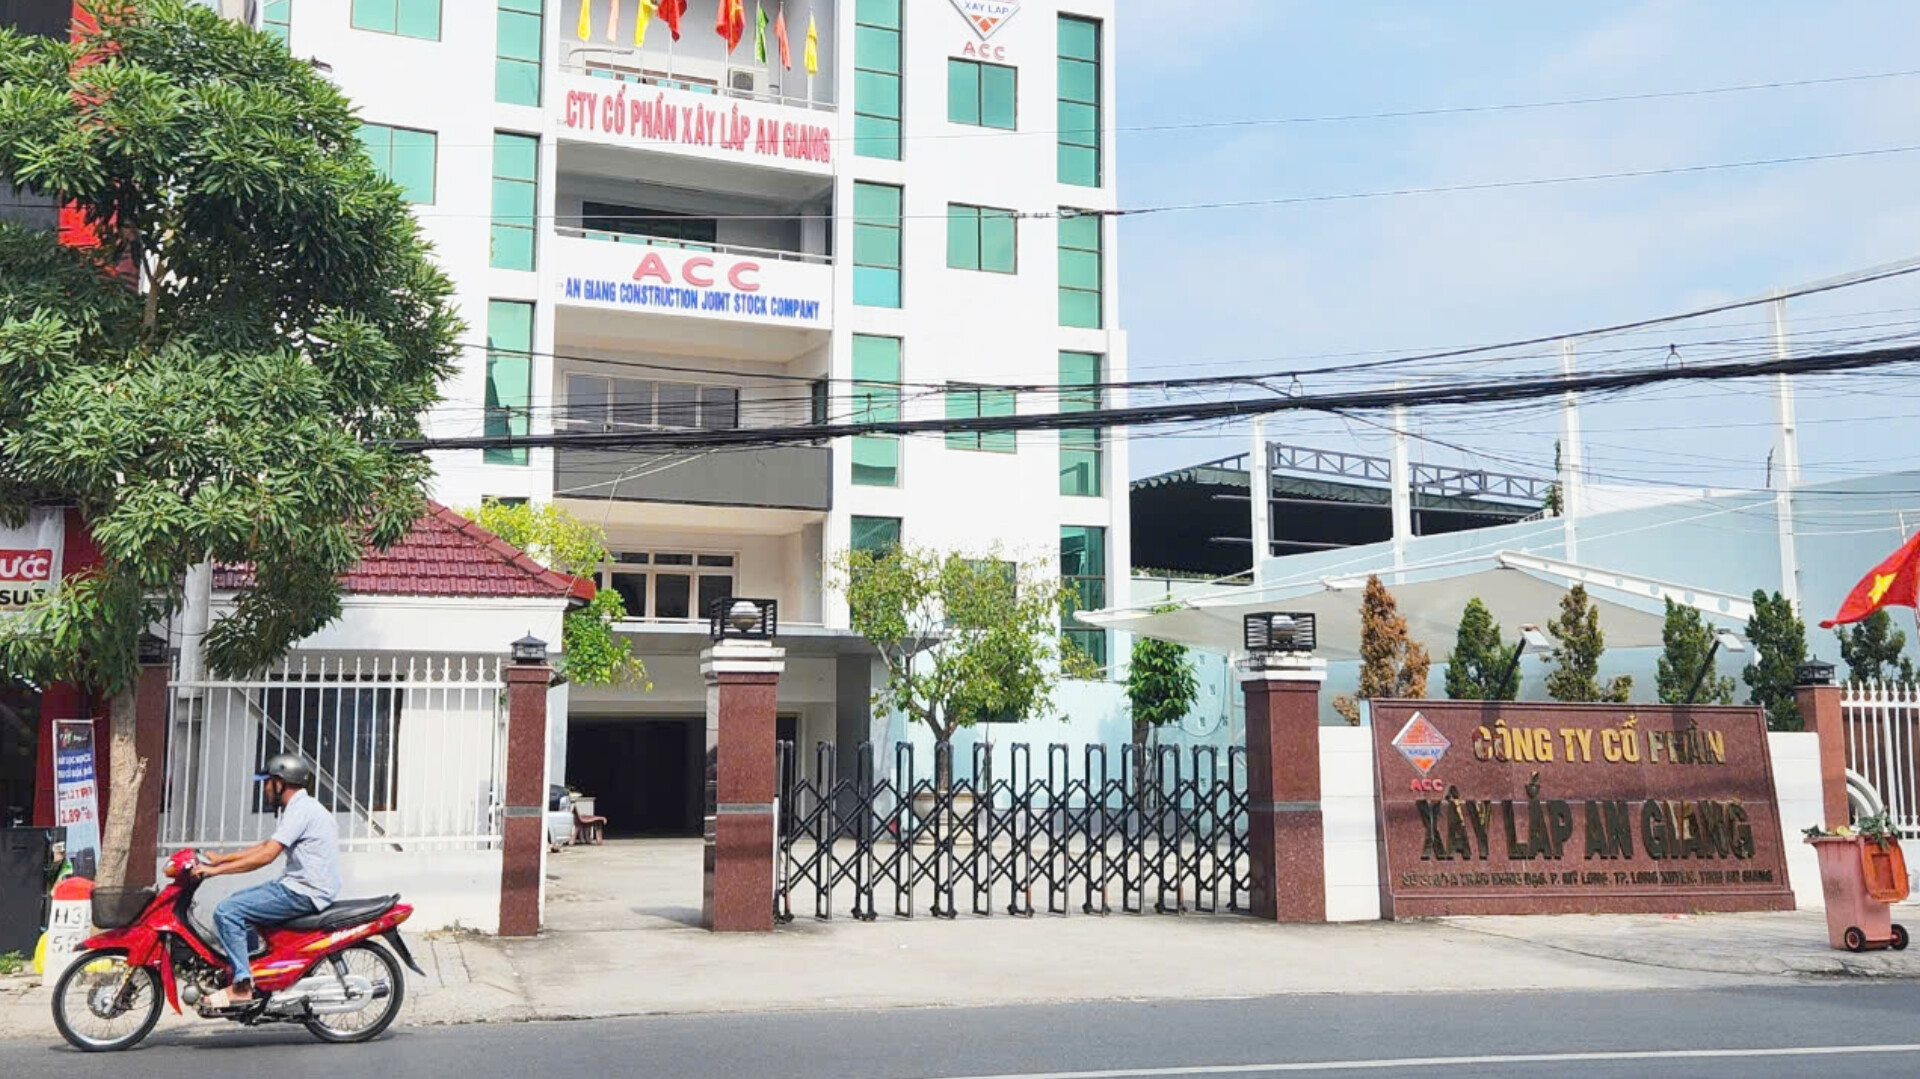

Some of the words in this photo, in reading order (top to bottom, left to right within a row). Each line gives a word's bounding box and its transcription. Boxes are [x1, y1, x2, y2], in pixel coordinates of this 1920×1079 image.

[962, 41, 1006, 61] ACC
[565, 90, 598, 131] CTY
[681, 102, 716, 147] XÂY
[755, 117, 780, 156] AN
[782, 121, 831, 164] GIANG
[632, 252, 761, 292] ACC
[566, 277, 582, 299] AN
[584, 280, 616, 302] GIANG
[619, 282, 698, 309] CONSTRUCTION
[701, 291, 730, 313] JOINT
[734, 293, 768, 315] STOCK
[770, 297, 820, 320] COMPANY
[1472, 719, 1554, 763] CÔNG
[1559, 727, 1593, 763] TY
[1601, 713, 1641, 764] CỔ
[1647, 718, 1727, 764] PHẦN
[1410, 778, 1444, 792] ACC
[1416, 784, 1491, 861] XÂY
[1501, 770, 1573, 861] LẮP
[1584, 798, 1635, 861] AN
[1642, 797, 1757, 861] GIANG
